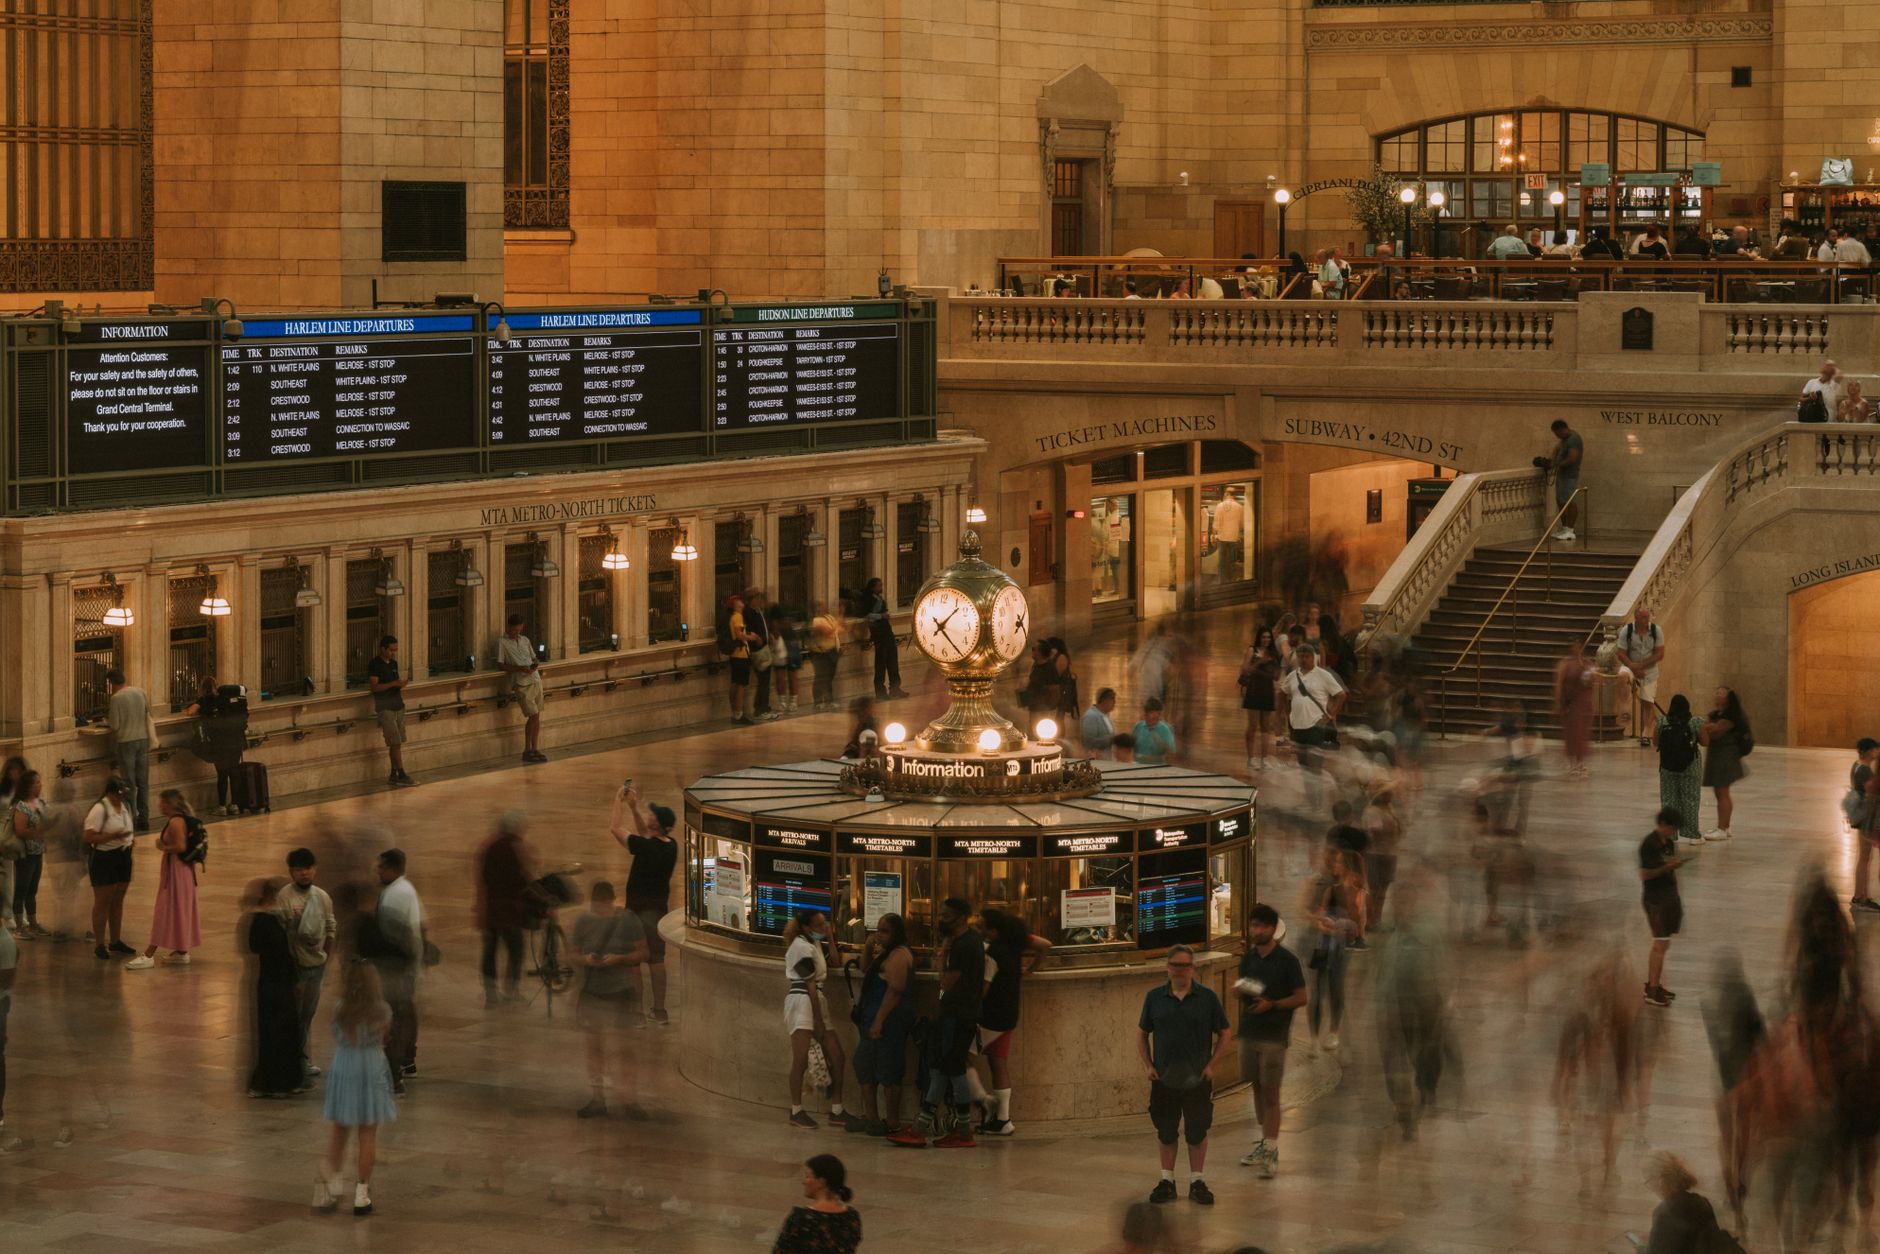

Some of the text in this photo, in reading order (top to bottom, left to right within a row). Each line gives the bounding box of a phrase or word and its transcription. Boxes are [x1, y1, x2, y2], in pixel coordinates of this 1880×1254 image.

[1528, 175, 1544, 188] EXIT
[1293, 178, 1353, 200] CIPRIANI
[541, 313, 650, 327] HARLEM LINE DEPARTURES
[759, 307, 854, 320] HUDSON LINE DEPARTURES
[102, 326, 168, 338] INFORMATION
[285, 319, 414, 334] HARLEM LINE DEPARTURES
[749, 331, 783, 339] DESTINATION
[509, 337, 611, 348] TRK DESTINATION REMARKS
[749, 344, 788, 353] CROTON-HARMON
[100, 352, 168, 363] Attention Customers:
[248, 349, 262, 357] TRK
[270, 347, 318, 357] DESTINATION
[336, 345, 367, 354] REMARKS
[553, 353, 570, 361] PLAINS
[584, 352, 608, 360] MELROSE
[612, 351, 620, 359] 1ST
[228, 366, 239, 374] 1:42
[253, 365, 262, 373] 110
[278, 363, 299, 372] WHITE
[299, 363, 319, 371] PLAINS
[336, 361, 364, 369] MELROSE
[368, 360, 379, 368] 1ST
[380, 360, 395, 368] STOP
[749, 358, 783, 366] POUGHKEEPSIE
[70, 368, 198, 383] For your safety and the safety of others,
[529, 368, 560, 377] SOUTHEAST
[601, 366, 618, 374] PLAINS
[620, 365, 630, 373] 1ST
[630, 365, 644, 373] STOP
[227, 375, 407, 391] 2:09 SOUTHEAST WHITE PLAINS 1ST STOP
[529, 383, 562, 392] CRESTWOOD
[71, 389, 94, 401] please
[95, 388, 104, 397] do
[105, 388, 116, 397] not
[137, 386, 147, 395] the
[149, 386, 163, 395] floor
[173, 384, 190, 394] stairs
[192, 384, 198, 393] in
[227, 391, 395, 407] 2:12 CRESTWOOD MELROSE 1ST STOP
[529, 398, 560, 407] SOUTHEAST
[584, 395, 616, 404] CRESTWOOD
[97, 402, 173, 415] Grand Central Terminal.
[228, 407, 395, 424] 2:42 N. WHITE PLAINS MELROSE 1ST STOP
[1601, 411, 1723, 427] WEST BALCONY
[84, 418, 186, 433] Thank you for your cooperation.
[228, 421, 410, 440] 3:09 SOUTHEAST CONNECTION TO WASSAIC
[529, 428, 560, 437] SOUTHEAST
[584, 424, 617, 433] CONNECTION
[624, 422, 647, 430] WASSAIC
[1036, 415, 1216, 453] TICKET MACHINES
[1285, 419, 1464, 461] SUBWAY 42ND ST
[228, 438, 395, 457] 3:12 CRESTWOOD MELROSE 1ST STOP
[481, 494, 656, 526] MTA METRO-NORTH TICKETS
[1791, 566, 1832, 588] LONG
[901, 758, 985, 777] Information
[780, 831, 820, 841] METRO-NORTH
[781, 838, 806, 846] ARRIVALS
[868, 838, 916, 846] METRO-NORTH
[1058, 836, 1119, 847] MTA METRO-NORTH
[865, 844, 903, 852] TIMETABLES
[1070, 843, 1107, 852] TIMETABLES
[775, 861, 813, 873] ARRIVALS
